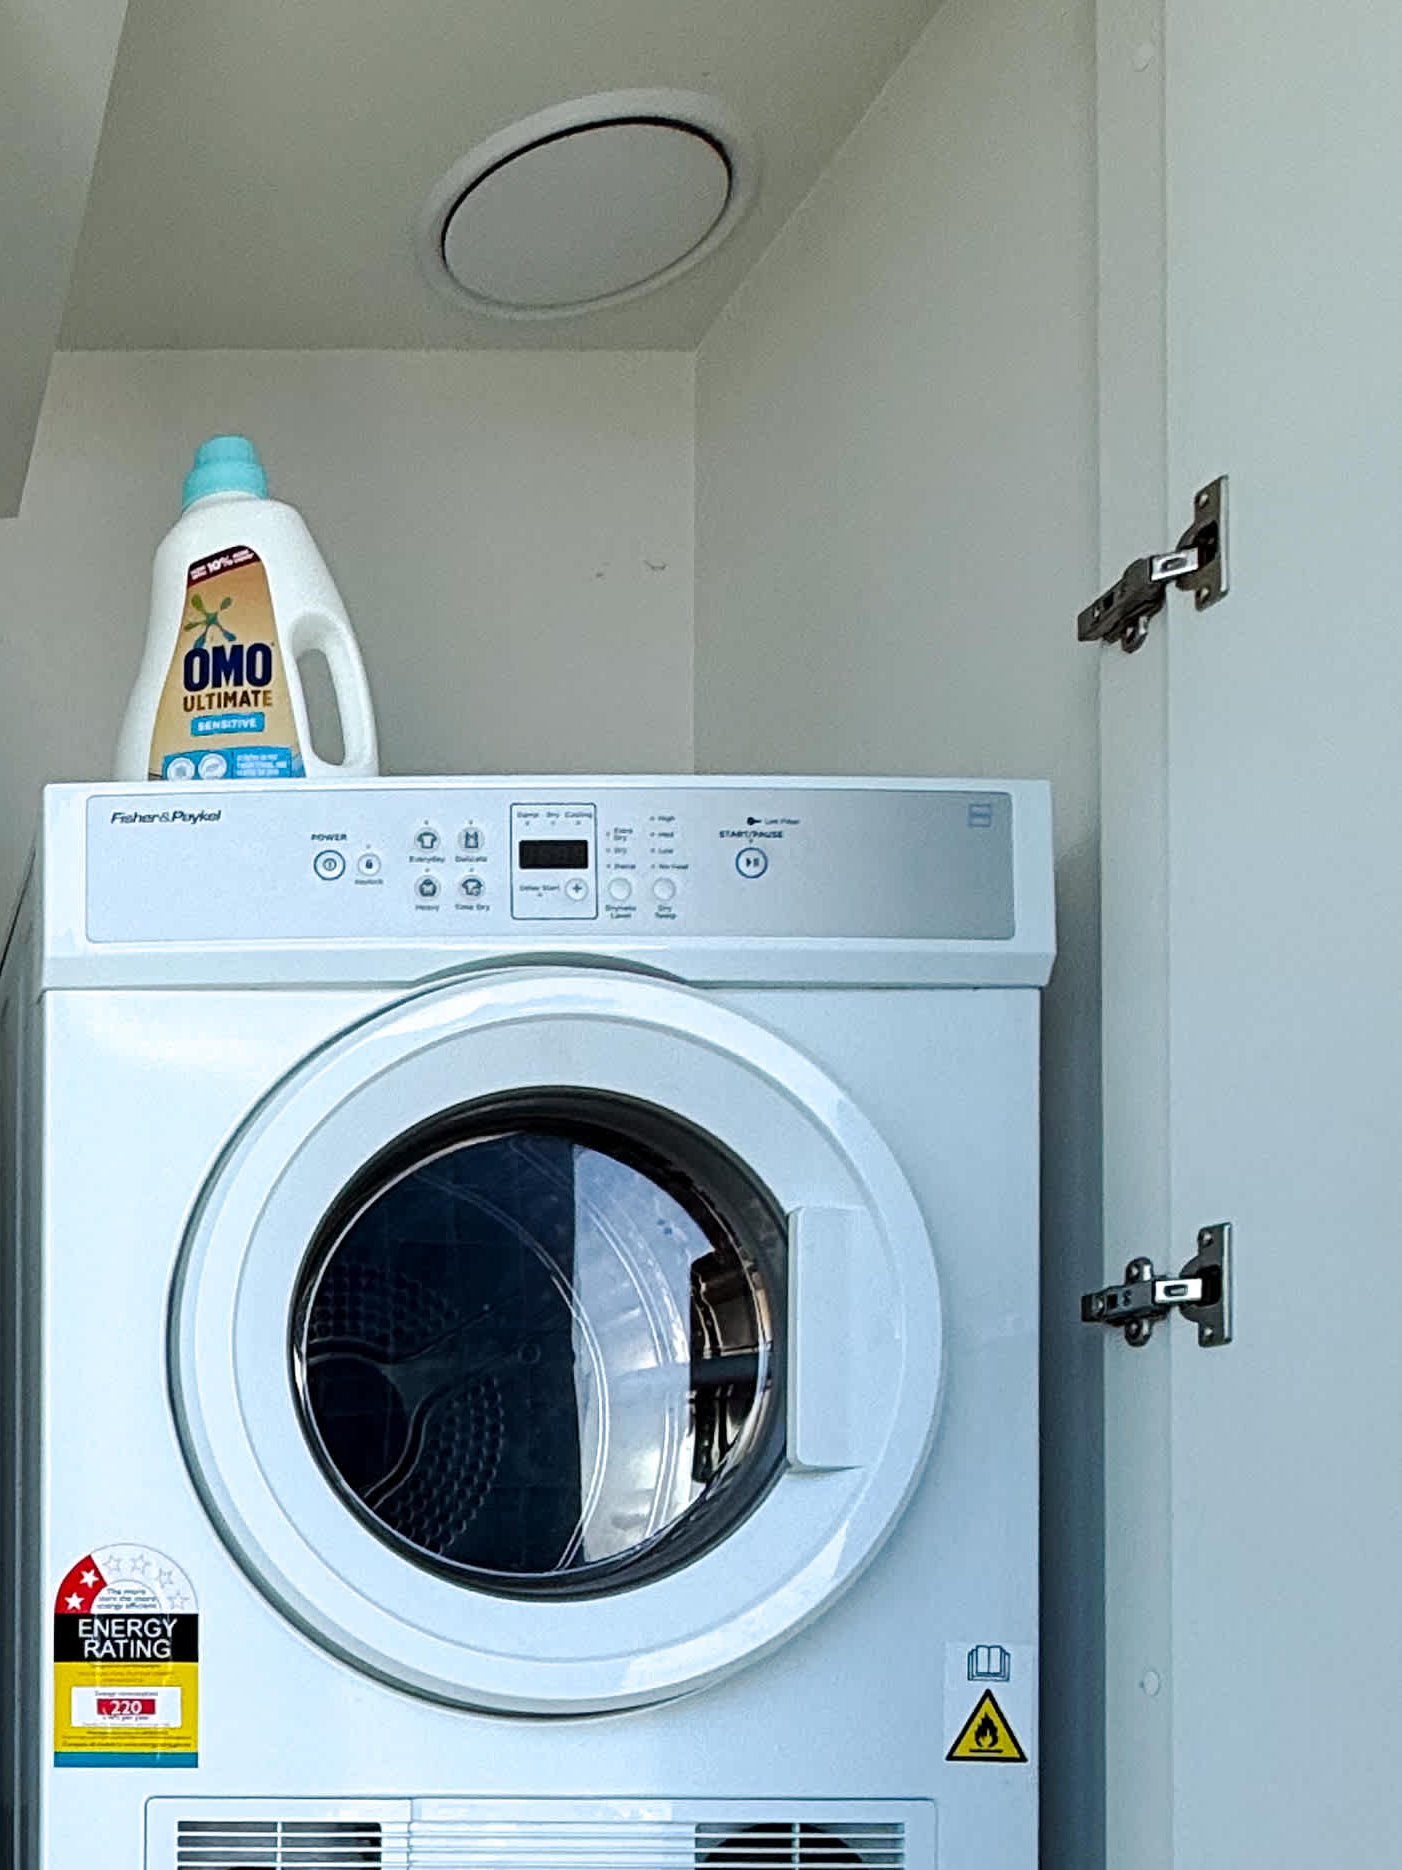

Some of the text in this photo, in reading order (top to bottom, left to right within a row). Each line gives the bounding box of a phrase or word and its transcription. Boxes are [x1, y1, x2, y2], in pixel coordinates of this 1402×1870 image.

[183, 642, 273, 692] OMO
[182, 690, 273, 713] ULTIMATE
[198, 717, 258, 732] SENSITIVE
[311, 833, 347, 841] POWER
[719, 830, 783, 838] START/PAUSE
[409, 856, 445, 864] Everyday
[78, 1617, 177, 1638] ENERGY
[84, 1638, 172, 1659] RATING
[110, 1700, 142, 1715] 220
